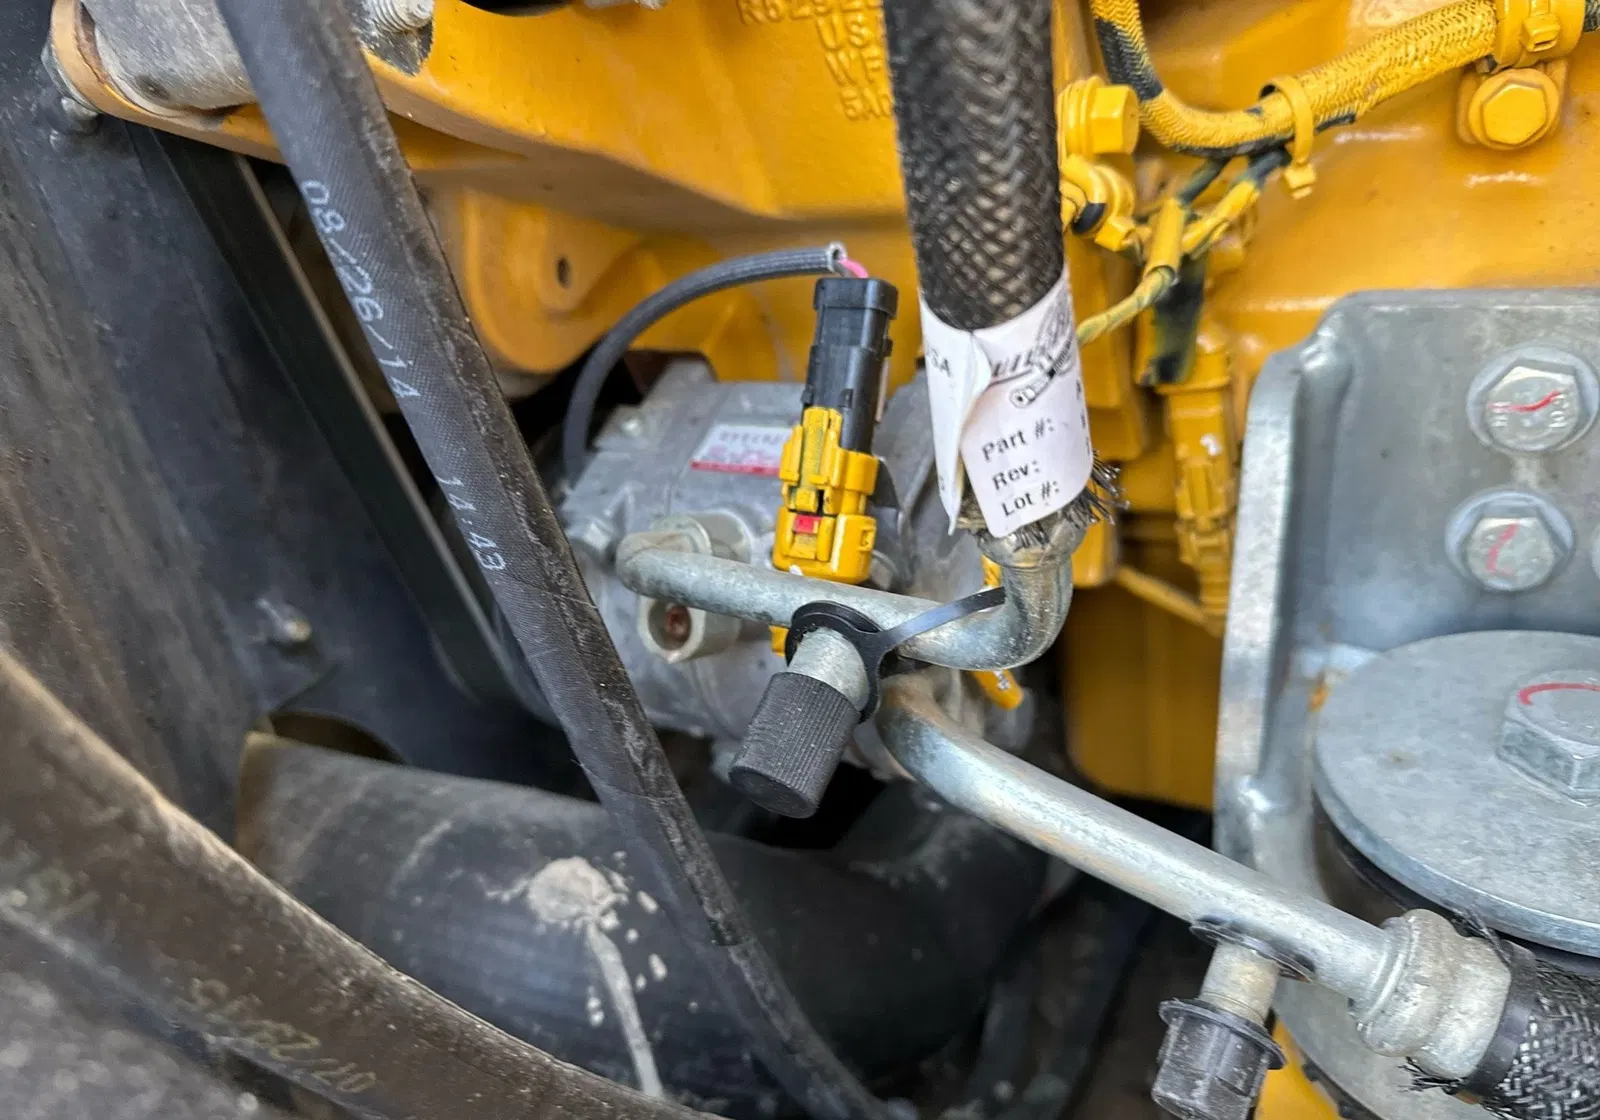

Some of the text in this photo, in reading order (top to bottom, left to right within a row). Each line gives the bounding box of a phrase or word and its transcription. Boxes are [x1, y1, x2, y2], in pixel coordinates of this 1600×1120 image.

[981, 430, 1027, 462] Part
[1035, 417, 1055, 440] #:
[992, 460, 1040, 490] Rev:
[1001, 480, 1060, 517] Lot #:
